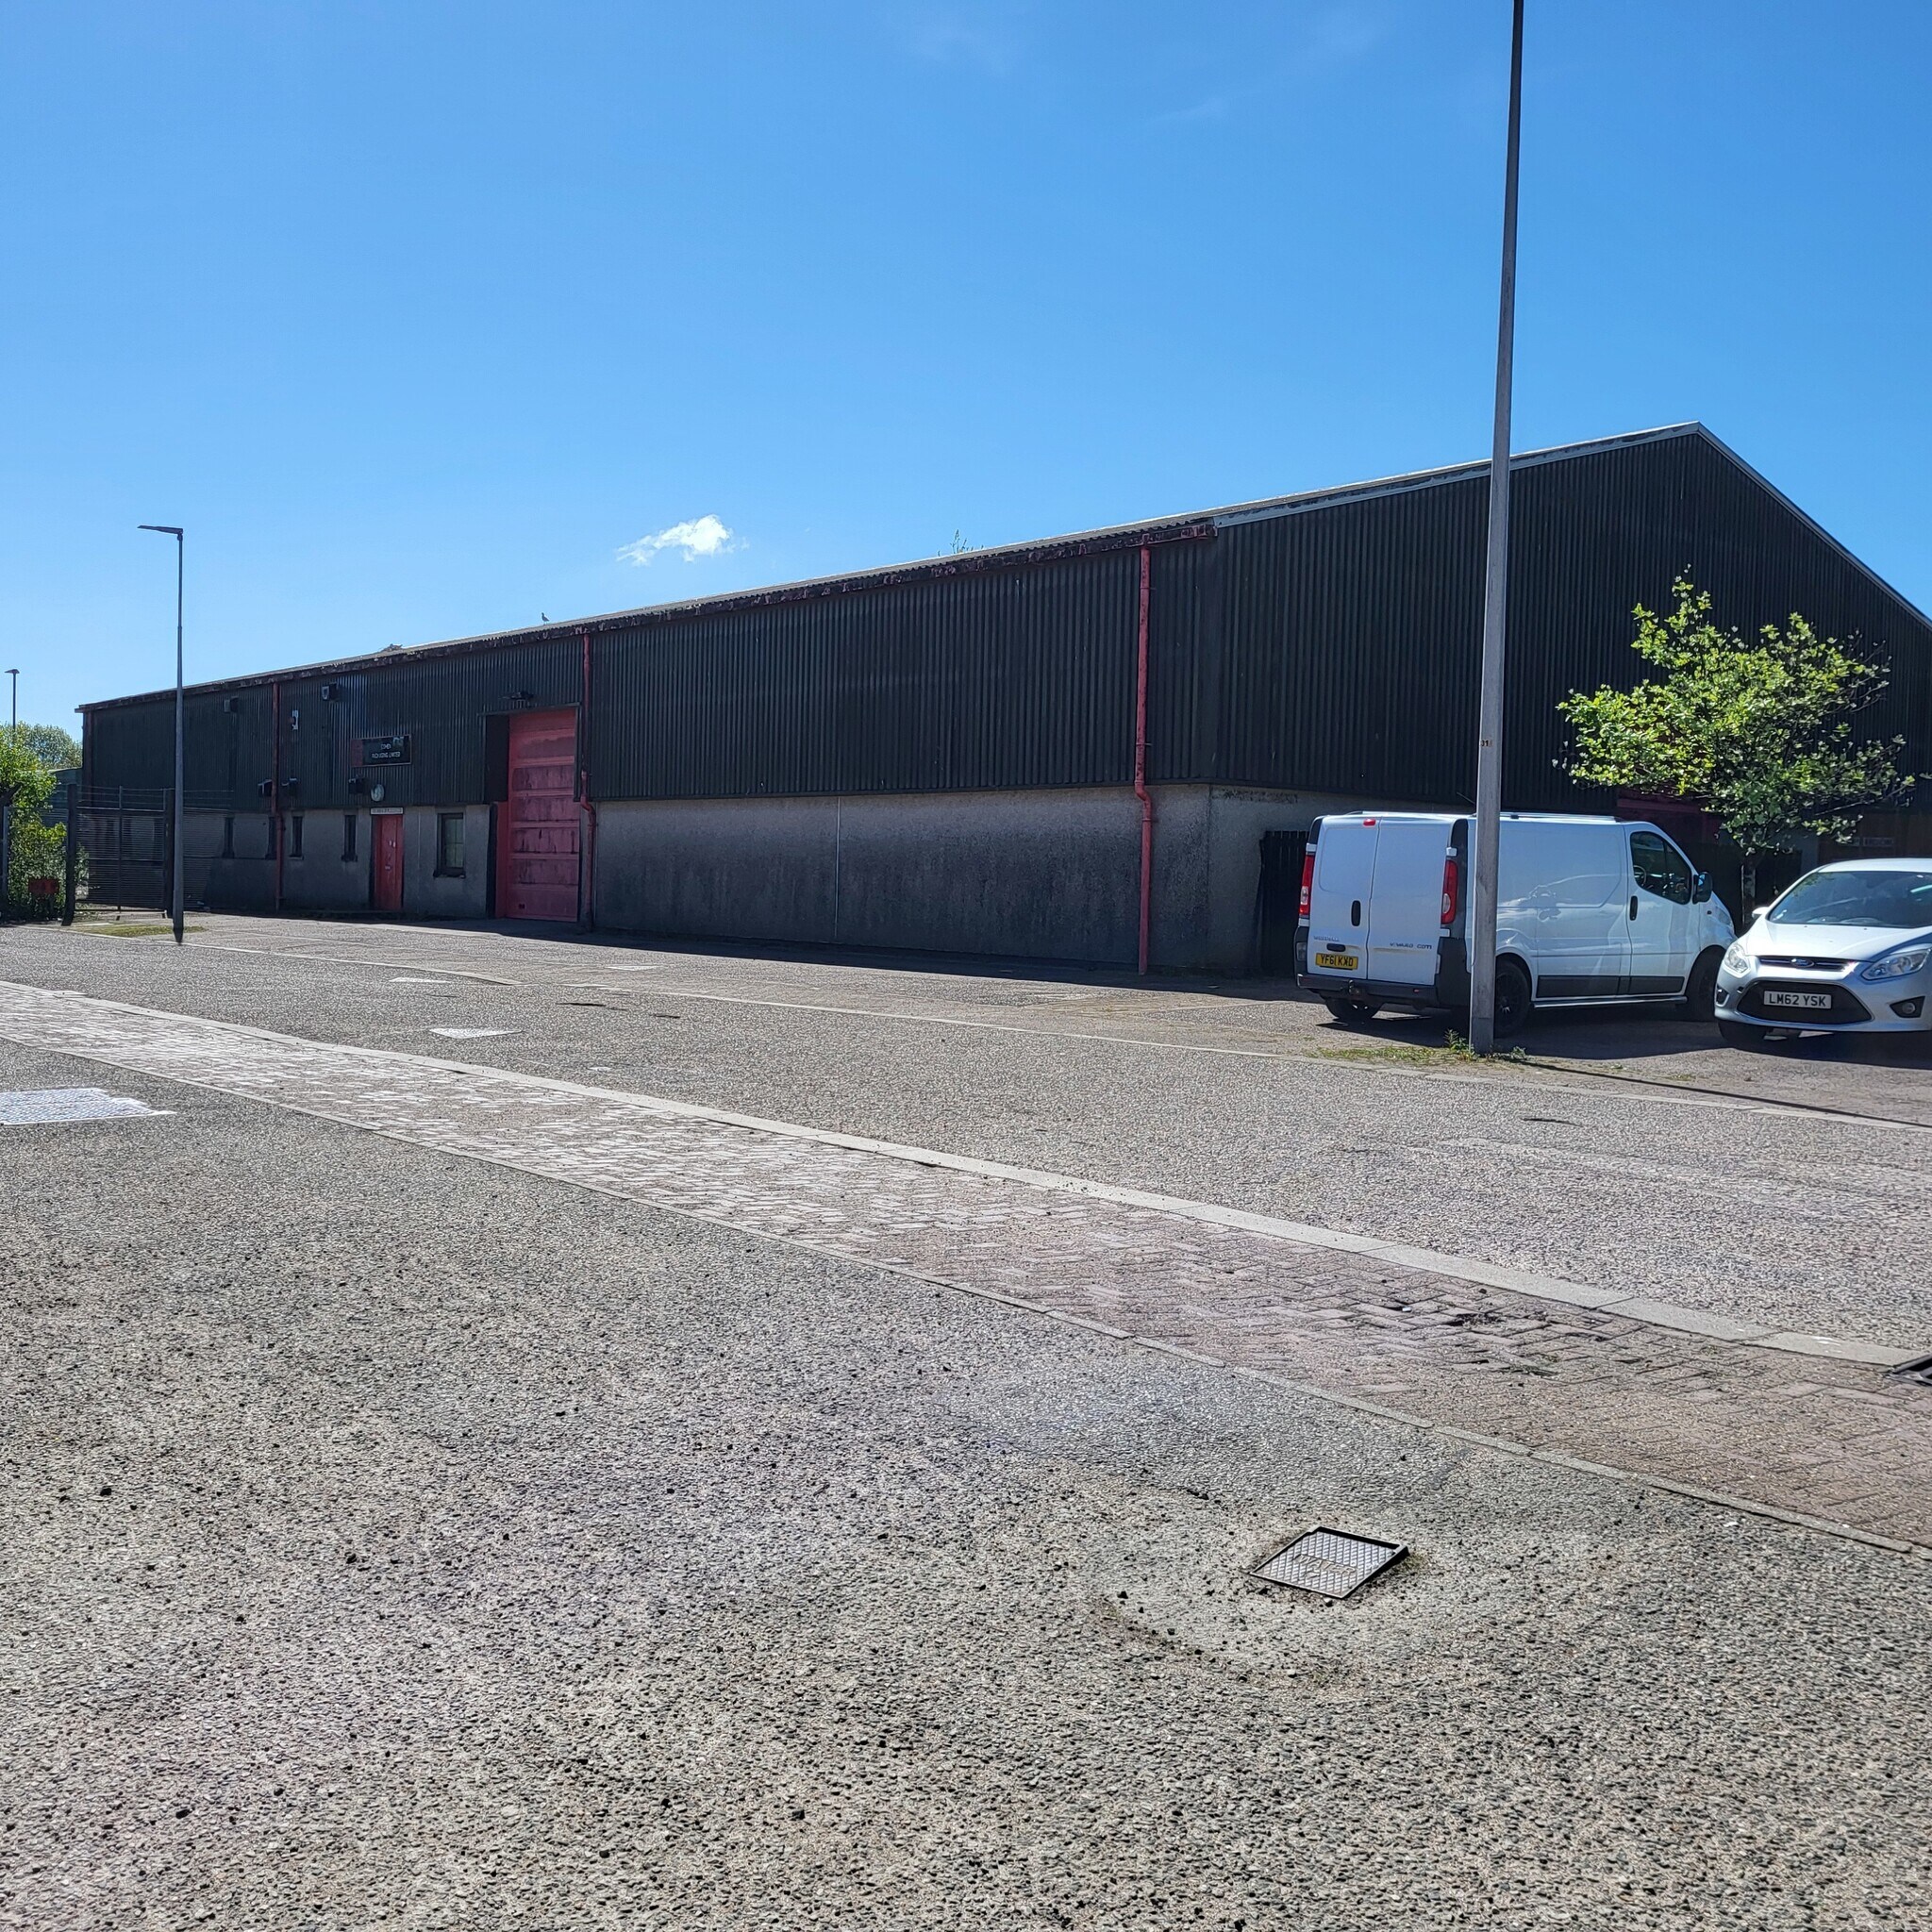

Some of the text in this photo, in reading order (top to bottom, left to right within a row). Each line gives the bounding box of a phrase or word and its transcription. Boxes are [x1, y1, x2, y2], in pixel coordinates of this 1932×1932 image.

[1769, 993, 1826, 1007] LM62 YSK
[1296, 1554, 1357, 1574] WATER
